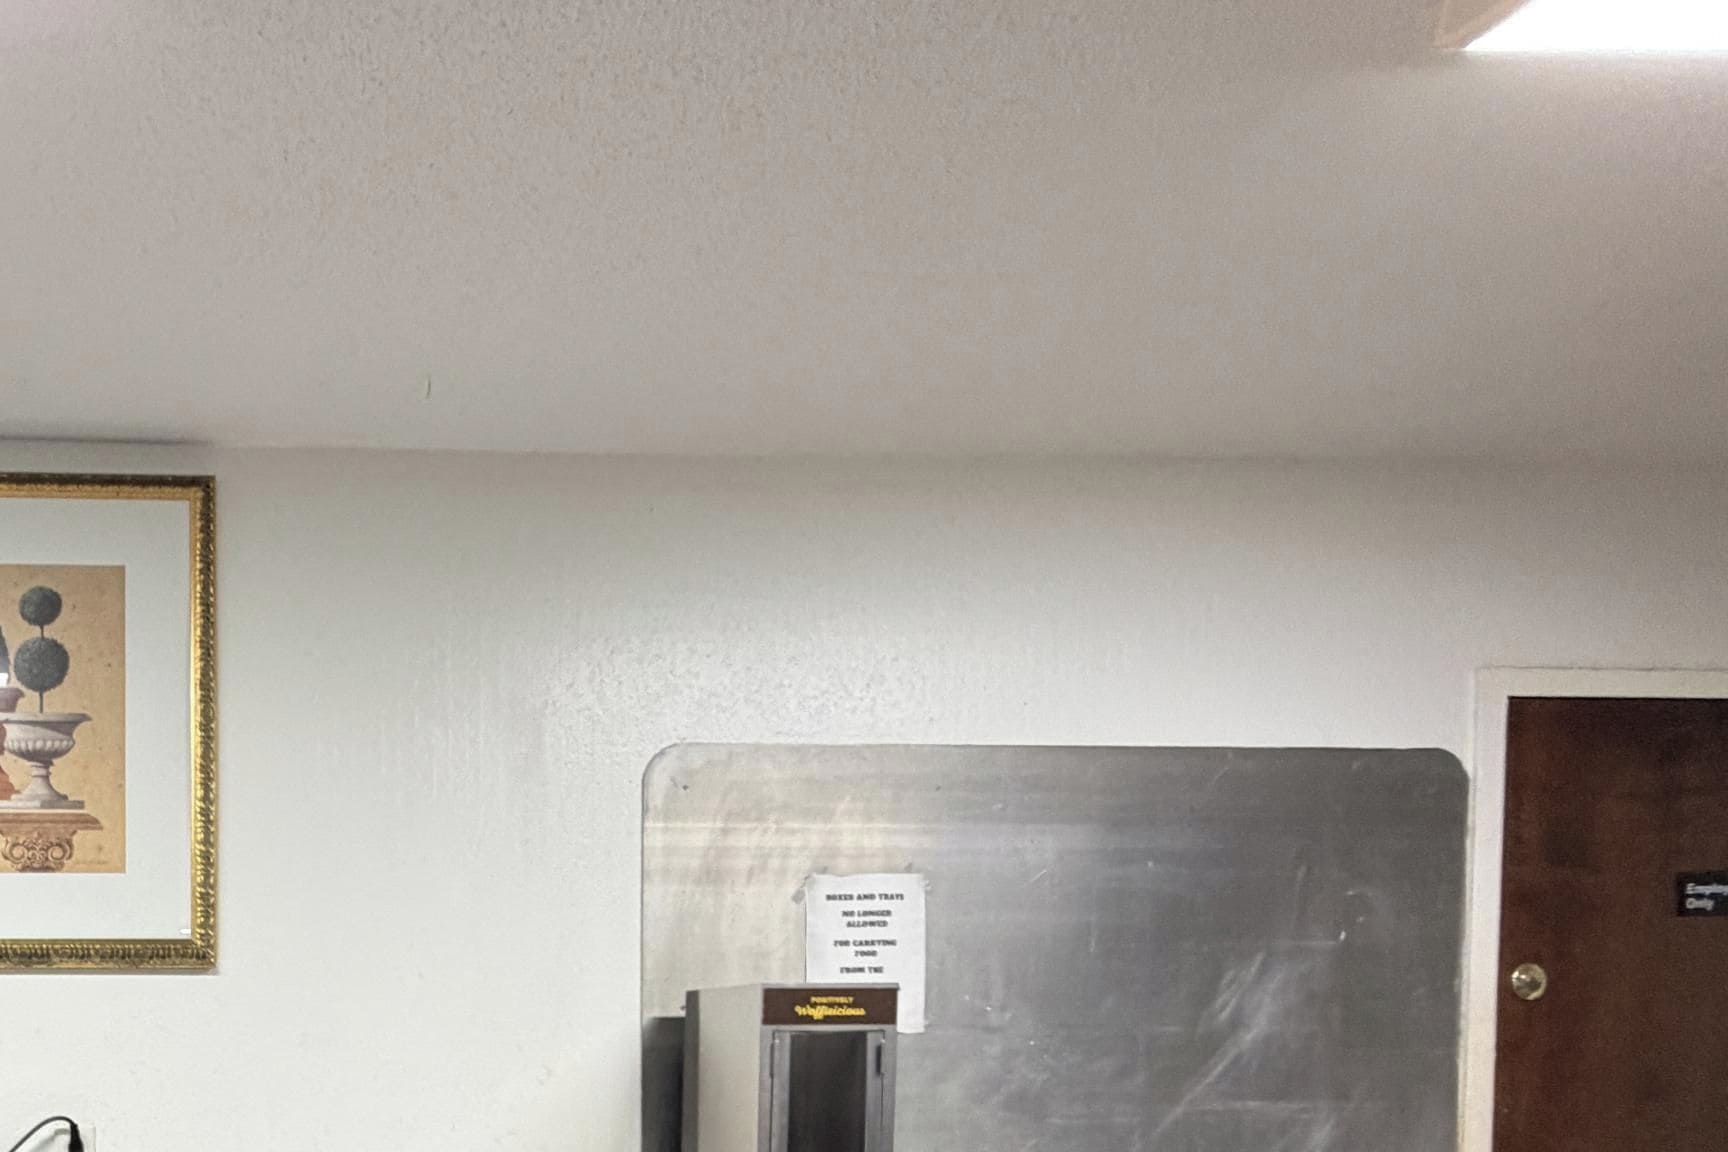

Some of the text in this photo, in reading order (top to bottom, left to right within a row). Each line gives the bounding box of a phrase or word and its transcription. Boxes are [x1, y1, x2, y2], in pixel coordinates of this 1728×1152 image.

[1685, 897, 1715, 911] Only
[857, 909, 892, 917] LONGER
[846, 920, 888, 928] ALLOWED
[852, 939, 897, 947] CARRYING
[867, 966, 884, 974] THE
